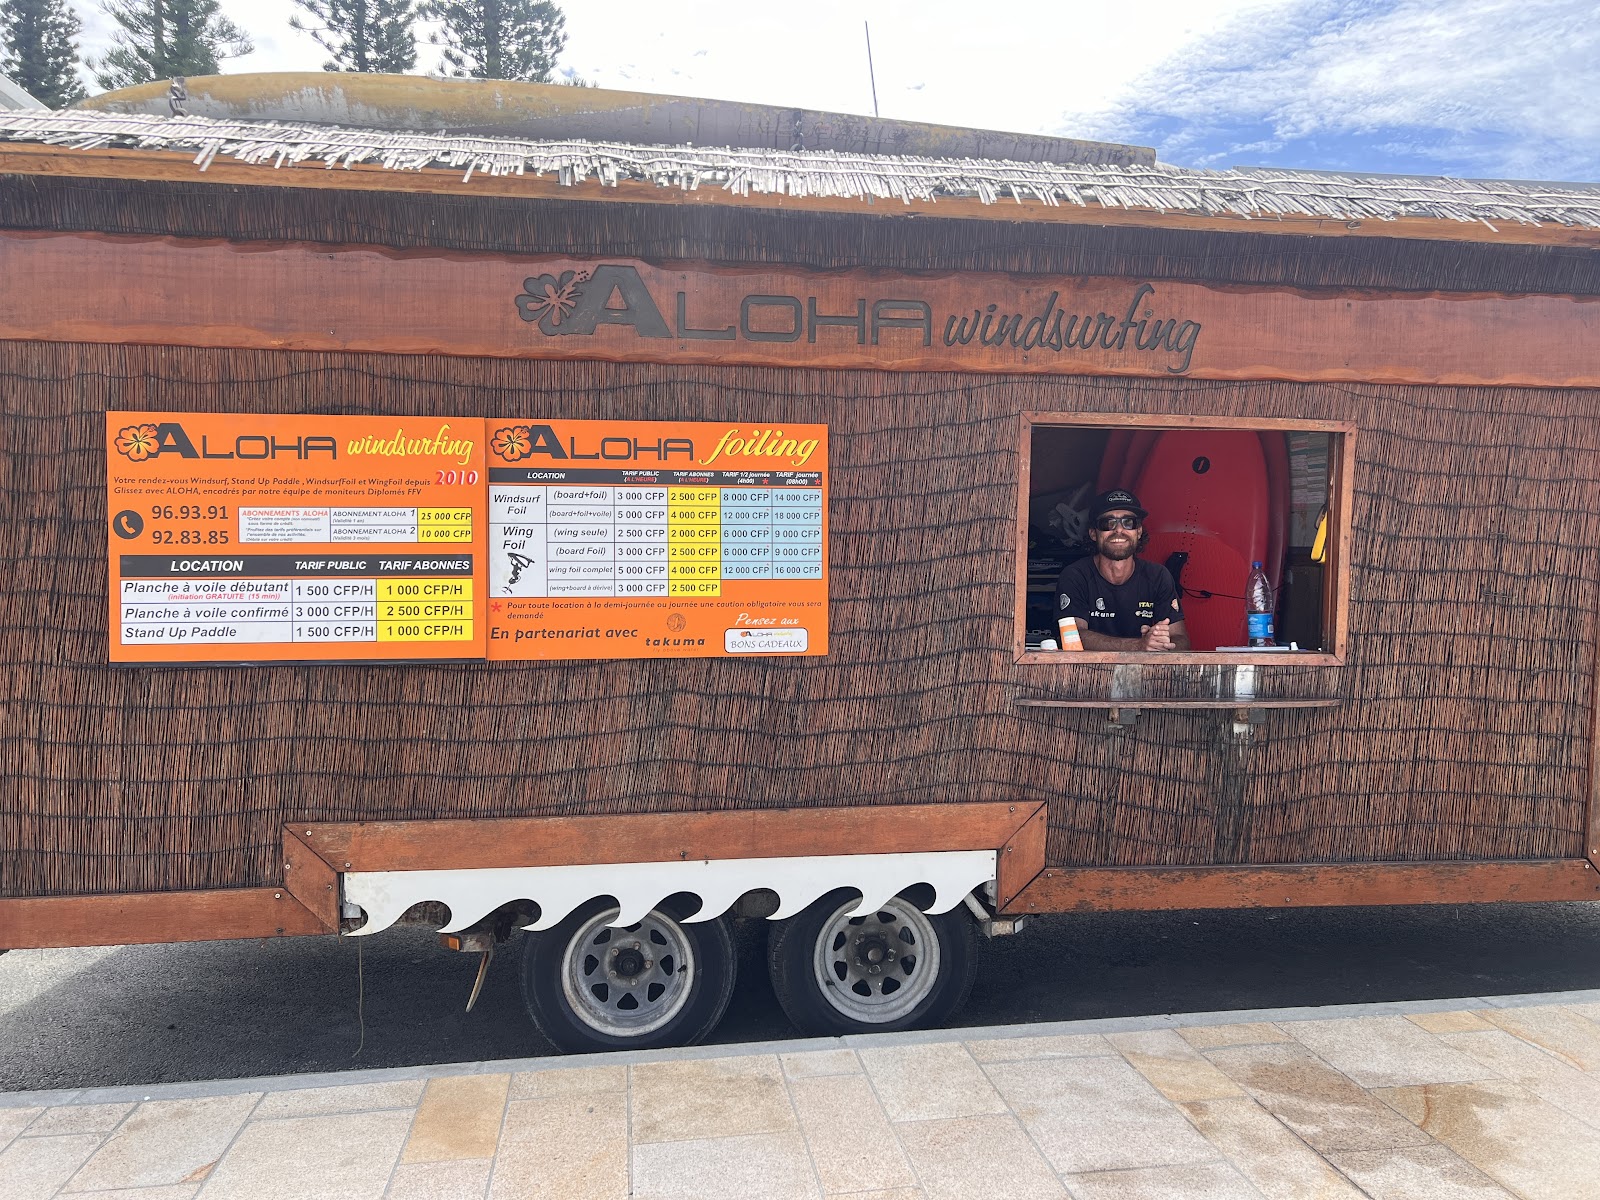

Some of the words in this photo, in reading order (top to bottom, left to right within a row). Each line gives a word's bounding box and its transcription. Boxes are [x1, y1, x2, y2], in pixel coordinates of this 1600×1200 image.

[577, 265, 932, 347] ALOHA
[943, 283, 1201, 373] windsurfing
[148, 422, 336, 459] ALOHA
[347, 424, 474, 466] windsurfing
[528, 424, 694, 462] ALOHA
[699, 429, 820, 466] foiling
[190, 477, 229, 485] Windsurf,
[258, 478, 270, 486] Up
[306, 478, 356, 486] WindsurfFoil
[368, 478, 402, 487] WingFoil
[405, 479, 430, 487] depuis
[434, 470, 478, 486] 2010
[166, 488, 201, 496] ALOHA,
[283, 488, 311, 497] équipe
[368, 488, 405, 497] Diplomés
[554, 490, 607, 500] (board+foil)
[494, 494, 540, 503] Windsurf
[152, 506, 228, 520] 96.93.91
[507, 506, 526, 514] Foil
[152, 530, 229, 544] 92.83.85
[503, 526, 533, 538] Wing
[554, 528, 579, 537] (wing
[581, 528, 608, 536] seule)
[503, 540, 526, 549] Foil
[556, 547, 584, 556] (board
[587, 547, 606, 556] Foil)
[170, 561, 243, 572] LOCATION
[295, 561, 325, 570] TARIF
[327, 561, 367, 570] PUBLIC
[379, 560, 412, 570] TARIF
[413, 560, 470, 570] ABONNES
[582, 566, 612, 574] complet
[124, 582, 179, 593] Planche
[183, 582, 190, 592] à
[195, 582, 226, 593] voile
[230, 582, 288, 592] débutant
[296, 586, 301, 595] 1
[307, 586, 329, 595] 500
[333, 586, 373, 595] CFP/H
[387, 585, 392, 595] 1
[398, 585, 419, 595] 000
[423, 585, 463, 595] CFP/H
[125, 608, 180, 619] Planche
[184, 608, 191, 618] à
[196, 607, 226, 618] voile
[231, 607, 288, 618] confirmé
[296, 606, 302, 616] 3
[307, 606, 329, 616] 000
[334, 606, 374, 616] CFP/H
[387, 606, 394, 616] 2
[398, 606, 420, 616] 500
[424, 606, 463, 616] CFP/H
[735, 613, 776, 626] Pensez
[125, 628, 164, 638] Stand
[169, 628, 187, 640] Up
[191, 627, 236, 637] Paddle
[297, 627, 302, 636] 1
[307, 626, 329, 636] 500
[334, 626, 374, 636] CFP/H
[387, 626, 392, 636] 1
[398, 626, 419, 635] 000
[424, 626, 463, 635] CFP/H
[491, 627, 509, 639] En
[514, 627, 600, 642] partenariat
[605, 628, 638, 638] avec
[646, 637, 706, 646] takuma
[730, 640, 756, 648] BONS
[758, 640, 802, 648] CADEAUX
